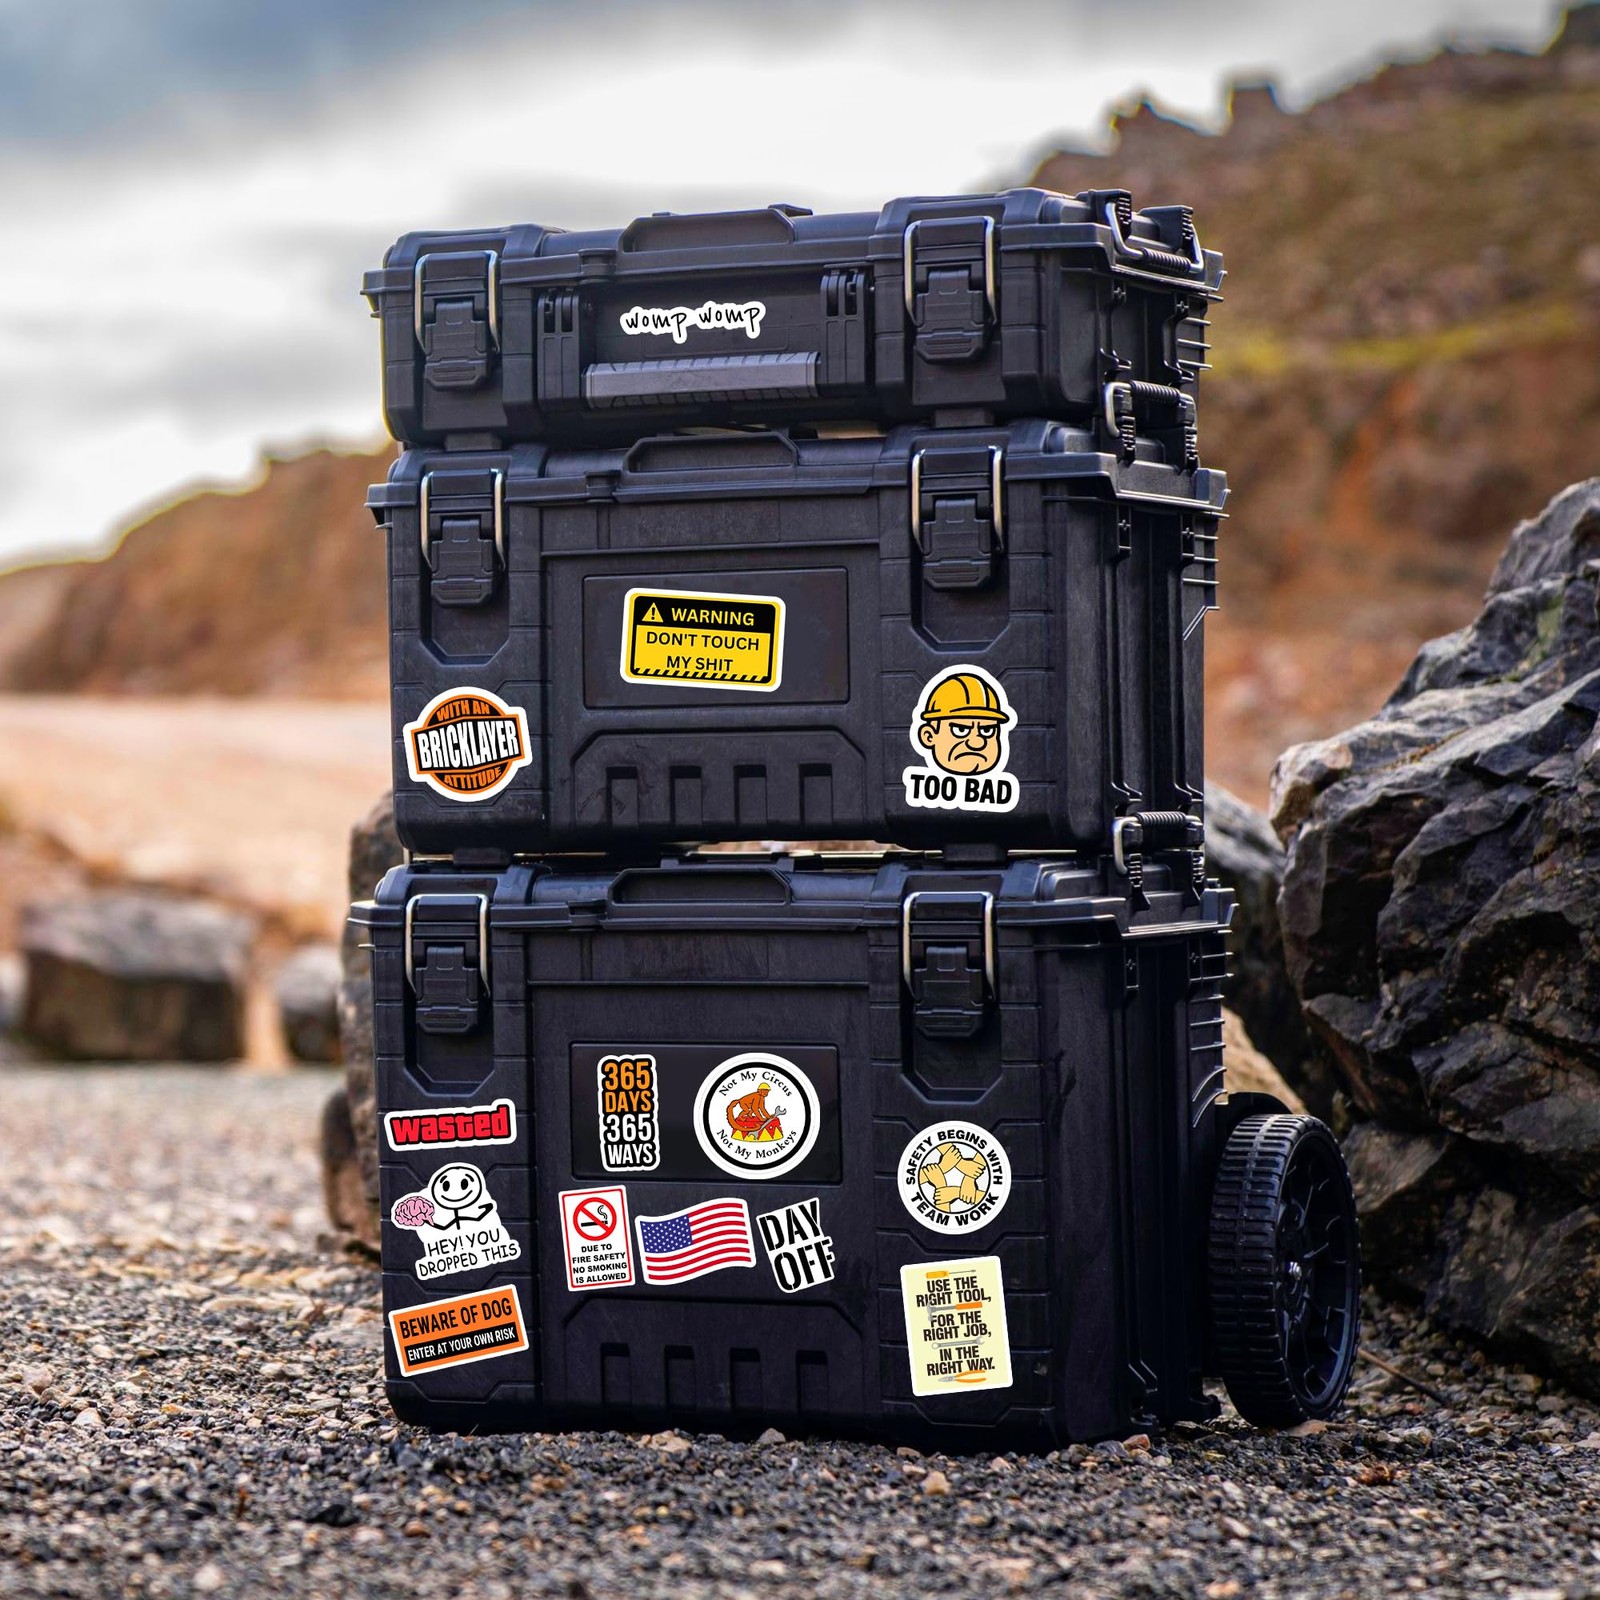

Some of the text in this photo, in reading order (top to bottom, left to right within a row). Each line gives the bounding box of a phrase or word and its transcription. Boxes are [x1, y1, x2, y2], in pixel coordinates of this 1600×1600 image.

[626, 307, 760, 338] womp womp
[671, 608, 754, 626] WARNING
[646, 631, 759, 651] DON'T TOUCH
[667, 656, 733, 671] MY SHIT
[437, 700, 490, 721] WITH AN
[417, 720, 520, 769] BRICKLAYER
[444, 767, 502, 789] ATTITUDE
[910, 774, 1012, 804] TOO BAD
[604, 1061, 650, 1090] 365
[719, 1071, 792, 1097] Not My Circus
[605, 1091, 651, 1113] DAYS
[390, 1104, 511, 1145] wasted
[606, 1113, 652, 1142] 365
[607, 1143, 653, 1165] WAYS
[717, 1129, 797, 1160] Not My Monkeys
[906, 1129, 1003, 1185] SAFETY BEGINS WITH
[911, 1192, 999, 1226] TEAM WORK
[759, 1200, 820, 1251] DAY
[428, 1228, 500, 1257] HEY! YOU
[581, 1243, 612, 1253] DUE TO
[419, 1243, 517, 1277] DROPPED THIS
[572, 1252, 626, 1264] FIRE SAFETY
[573, 1262, 627, 1274] NO SMOKING
[774, 1238, 832, 1290] OFF
[575, 1272, 626, 1284] IS ALLOWED
[926, 1276, 978, 1293] USE THE
[916, 1288, 991, 1307] RIGHT TOOL,
[399, 1297, 512, 1339] BEWARE OF DOG
[930, 1311, 982, 1328] FOR THE
[923, 1323, 992, 1341] RIGHT JOB,
[407, 1327, 516, 1361] ENTER AT YOUR OWN RISK
[939, 1345, 980, 1361] IN THE
[927, 1357, 995, 1376] RIGHT WAY.
